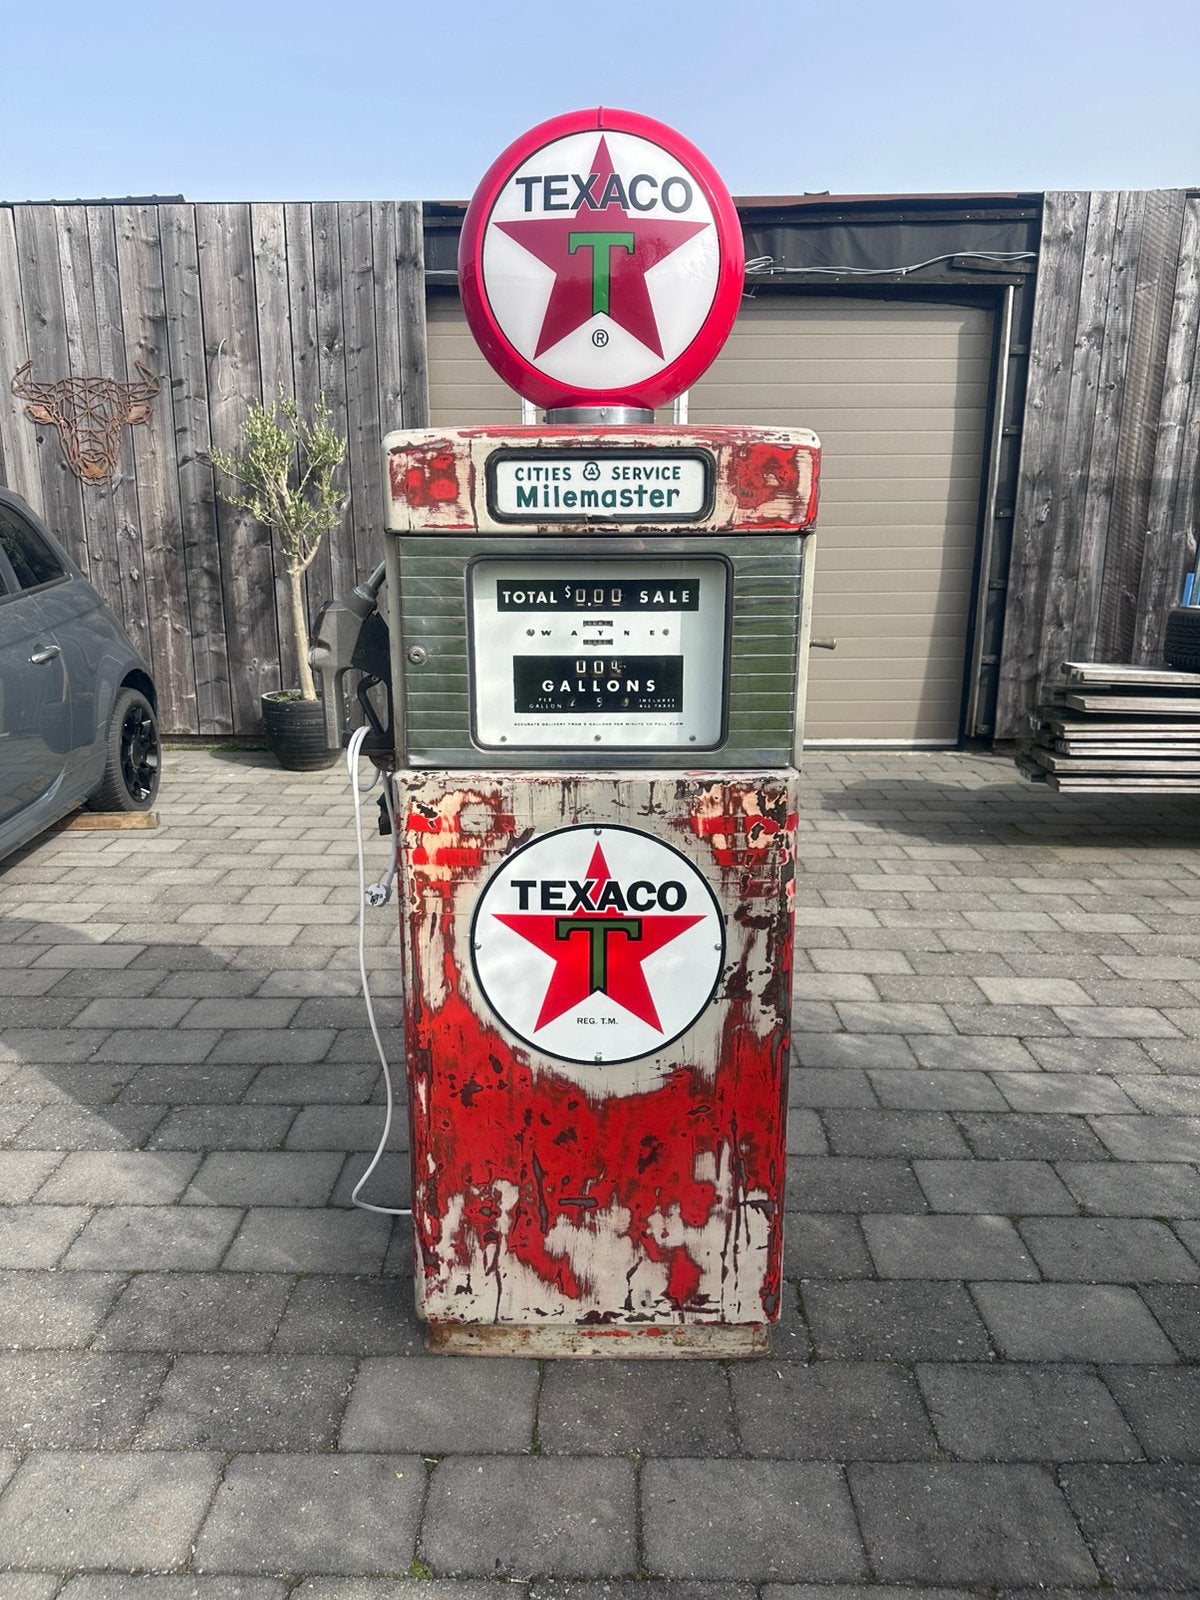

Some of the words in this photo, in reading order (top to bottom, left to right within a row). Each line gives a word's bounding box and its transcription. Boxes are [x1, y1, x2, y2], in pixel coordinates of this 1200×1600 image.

[515, 173, 693, 213] TEXACO
[568, 231, 635, 317] T
[514, 466, 572, 482] CITIES
[611, 466, 682, 481] SERVICE
[515, 484, 680, 508] Milemaster
[502, 591, 558, 604] TOTAL
[639, 590, 690, 604] SALE
[541, 679, 656, 692] GALLONS
[510, 880, 687, 912] TEXACO
[555, 917, 642, 996] T
[576, 1017, 598, 1025] REG.
[600, 1017, 619, 1025] T.M.
